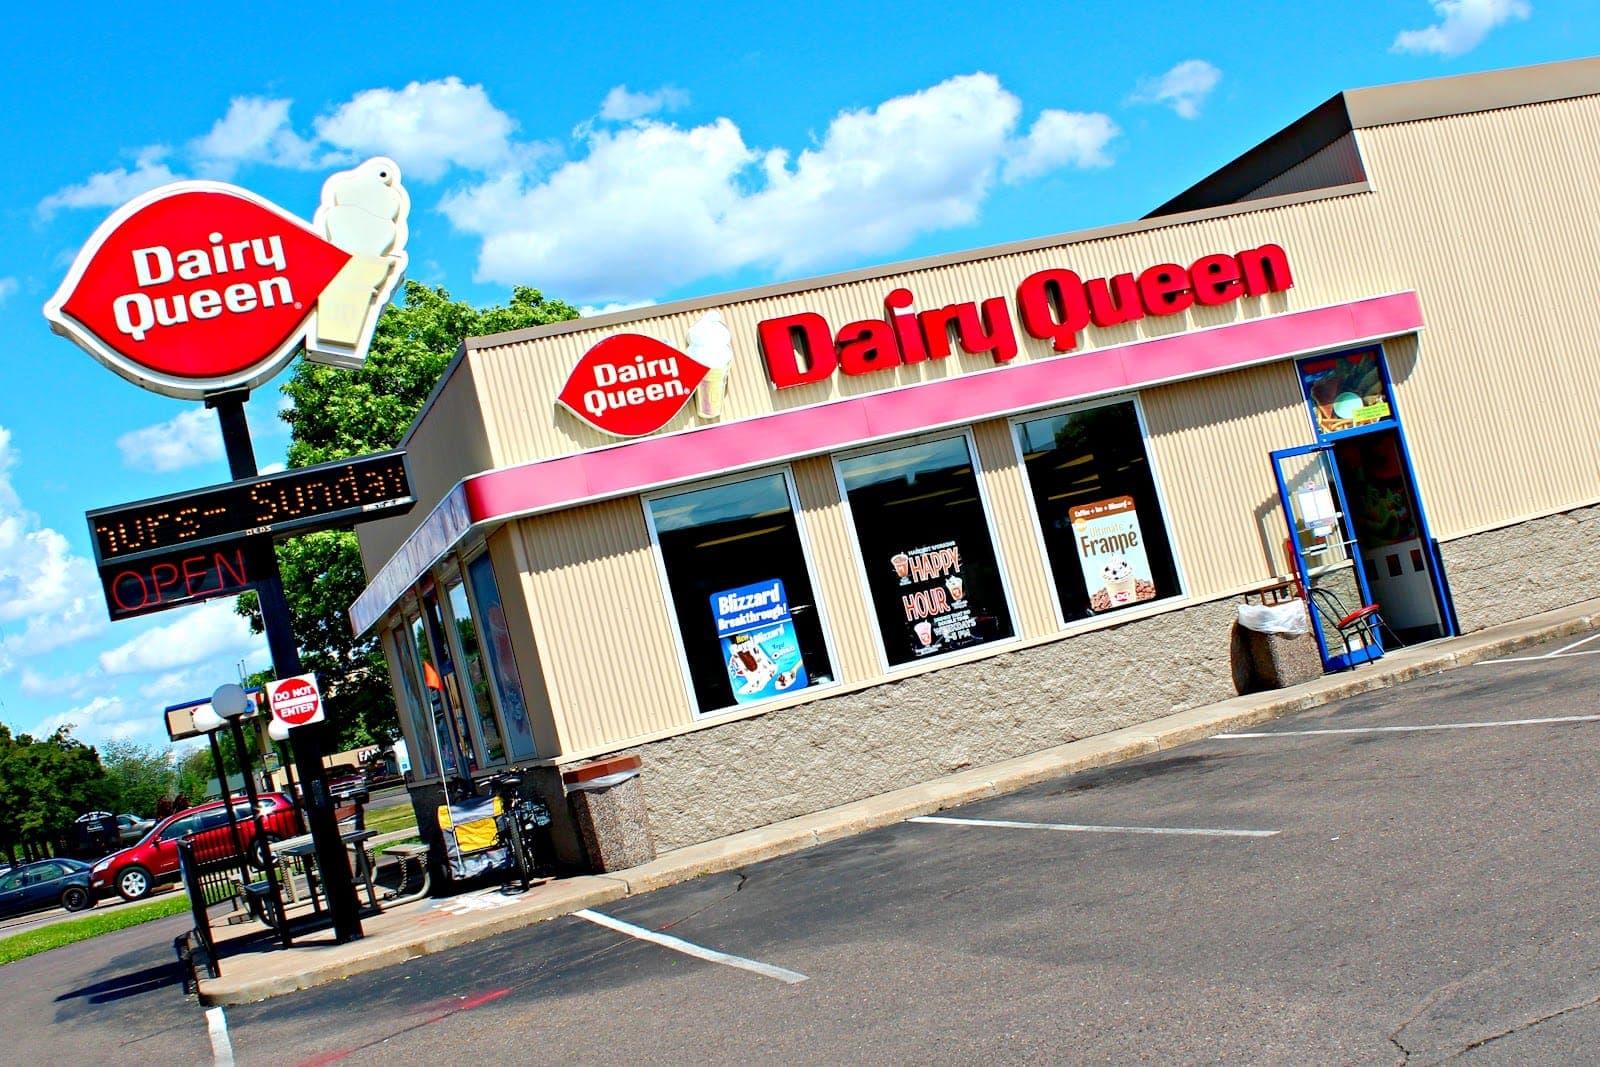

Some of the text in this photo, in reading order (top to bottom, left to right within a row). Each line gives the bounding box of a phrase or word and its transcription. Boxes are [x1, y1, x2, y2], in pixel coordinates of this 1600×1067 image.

[131, 232, 288, 288] Dairy
[112, 275, 294, 342] Queen
[757, 243, 1294, 391] Dairy Queen
[592, 355, 680, 388] Dairy
[583, 379, 686, 417] Queen
[250, 466, 404, 521] Sunday
[1080, 524, 1138, 558] Frappé
[111, 549, 248, 611] OPEN
[908, 546, 961, 583] HAPPY
[717, 582, 780, 616] Blizzard
[902, 587, 951, 622] HOUR
[275, 685, 313, 702] DO NOT
[280, 702, 315, 718] ENTER
